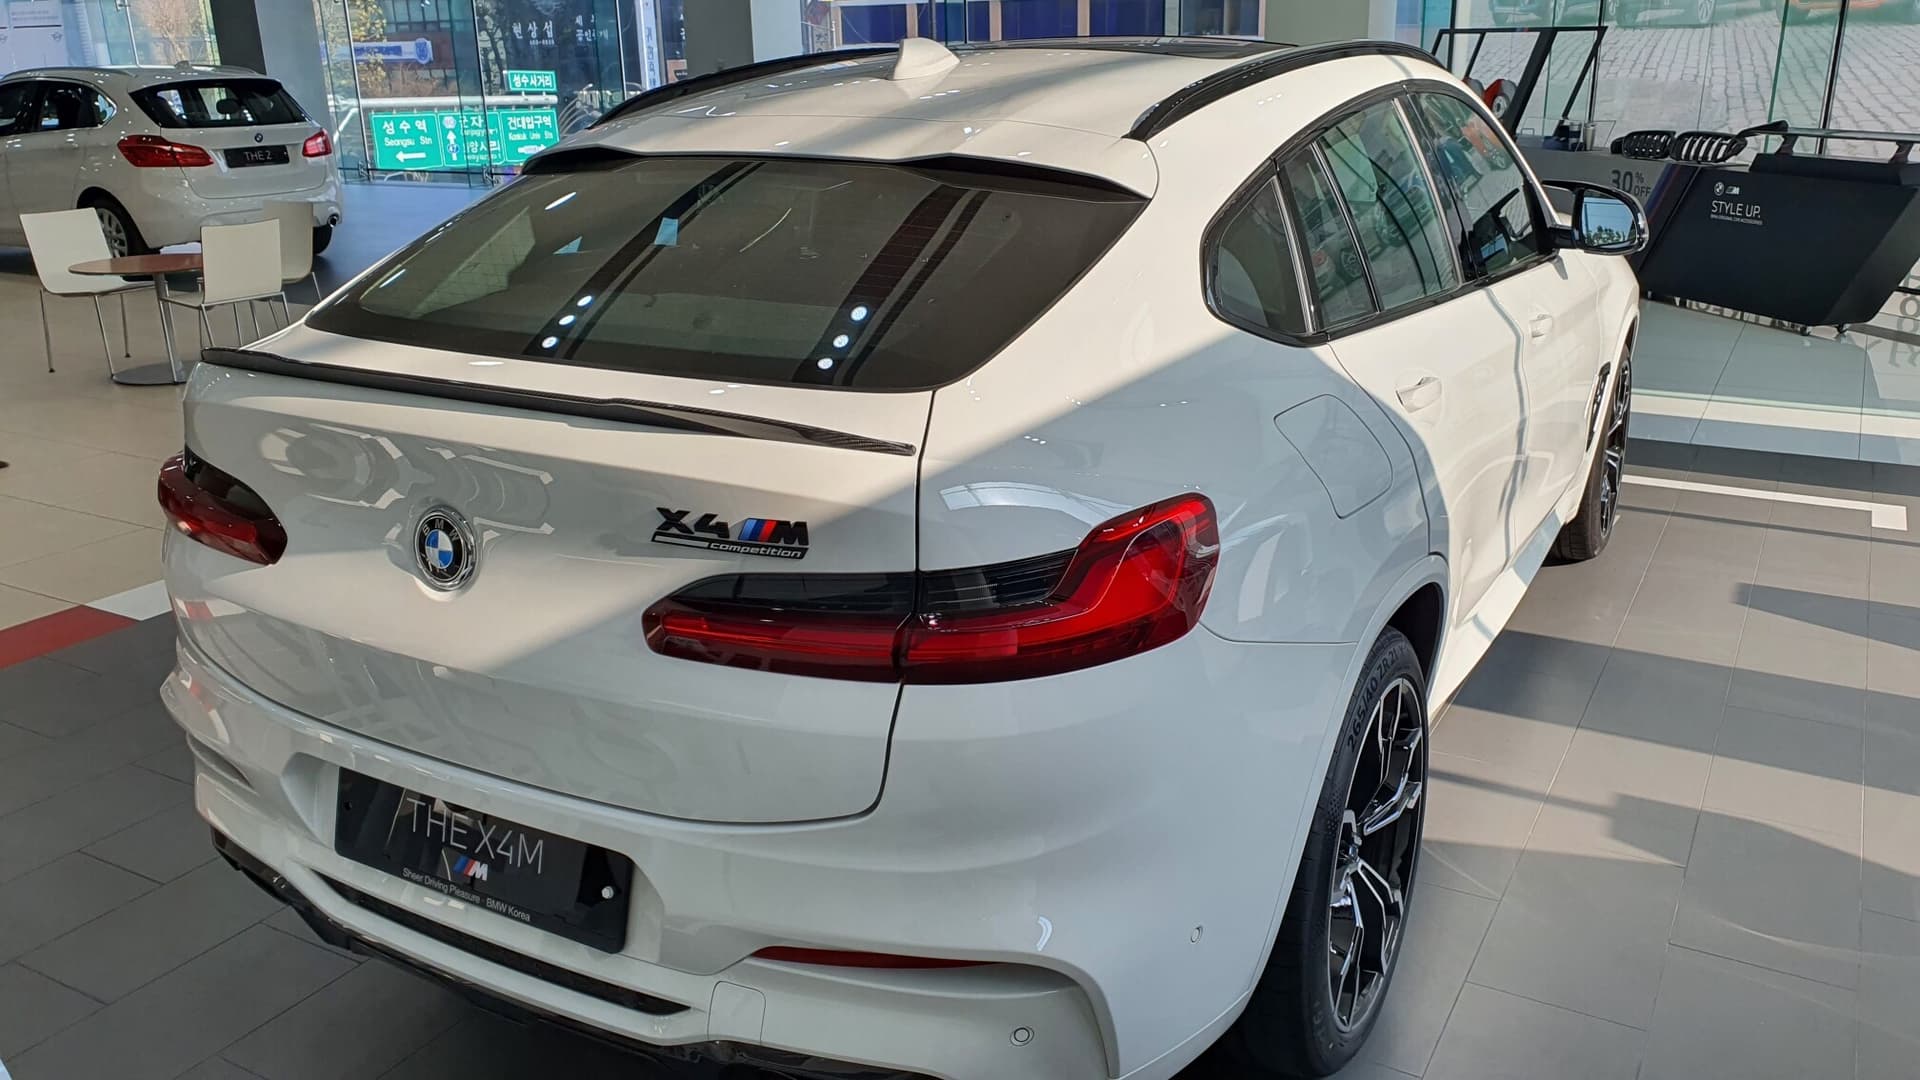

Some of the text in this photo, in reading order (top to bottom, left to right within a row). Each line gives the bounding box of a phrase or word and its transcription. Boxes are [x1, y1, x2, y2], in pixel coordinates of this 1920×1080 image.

[512, 74, 552, 88] 성수사거리
[508, 115, 552, 130] 건대입구역
[384, 136, 432, 148] Seongsu Stn
[243, 150, 272, 161] THE 2
[1711, 200, 1761, 218] STYLE UP.
[422, 519, 460, 541] BMW
[656, 507, 730, 539] X4
[709, 541, 802, 558] competition
[405, 797, 544, 875] THE X4M
[402, 866, 531, 922] Sheer Driving Pleasure BMW Korea
